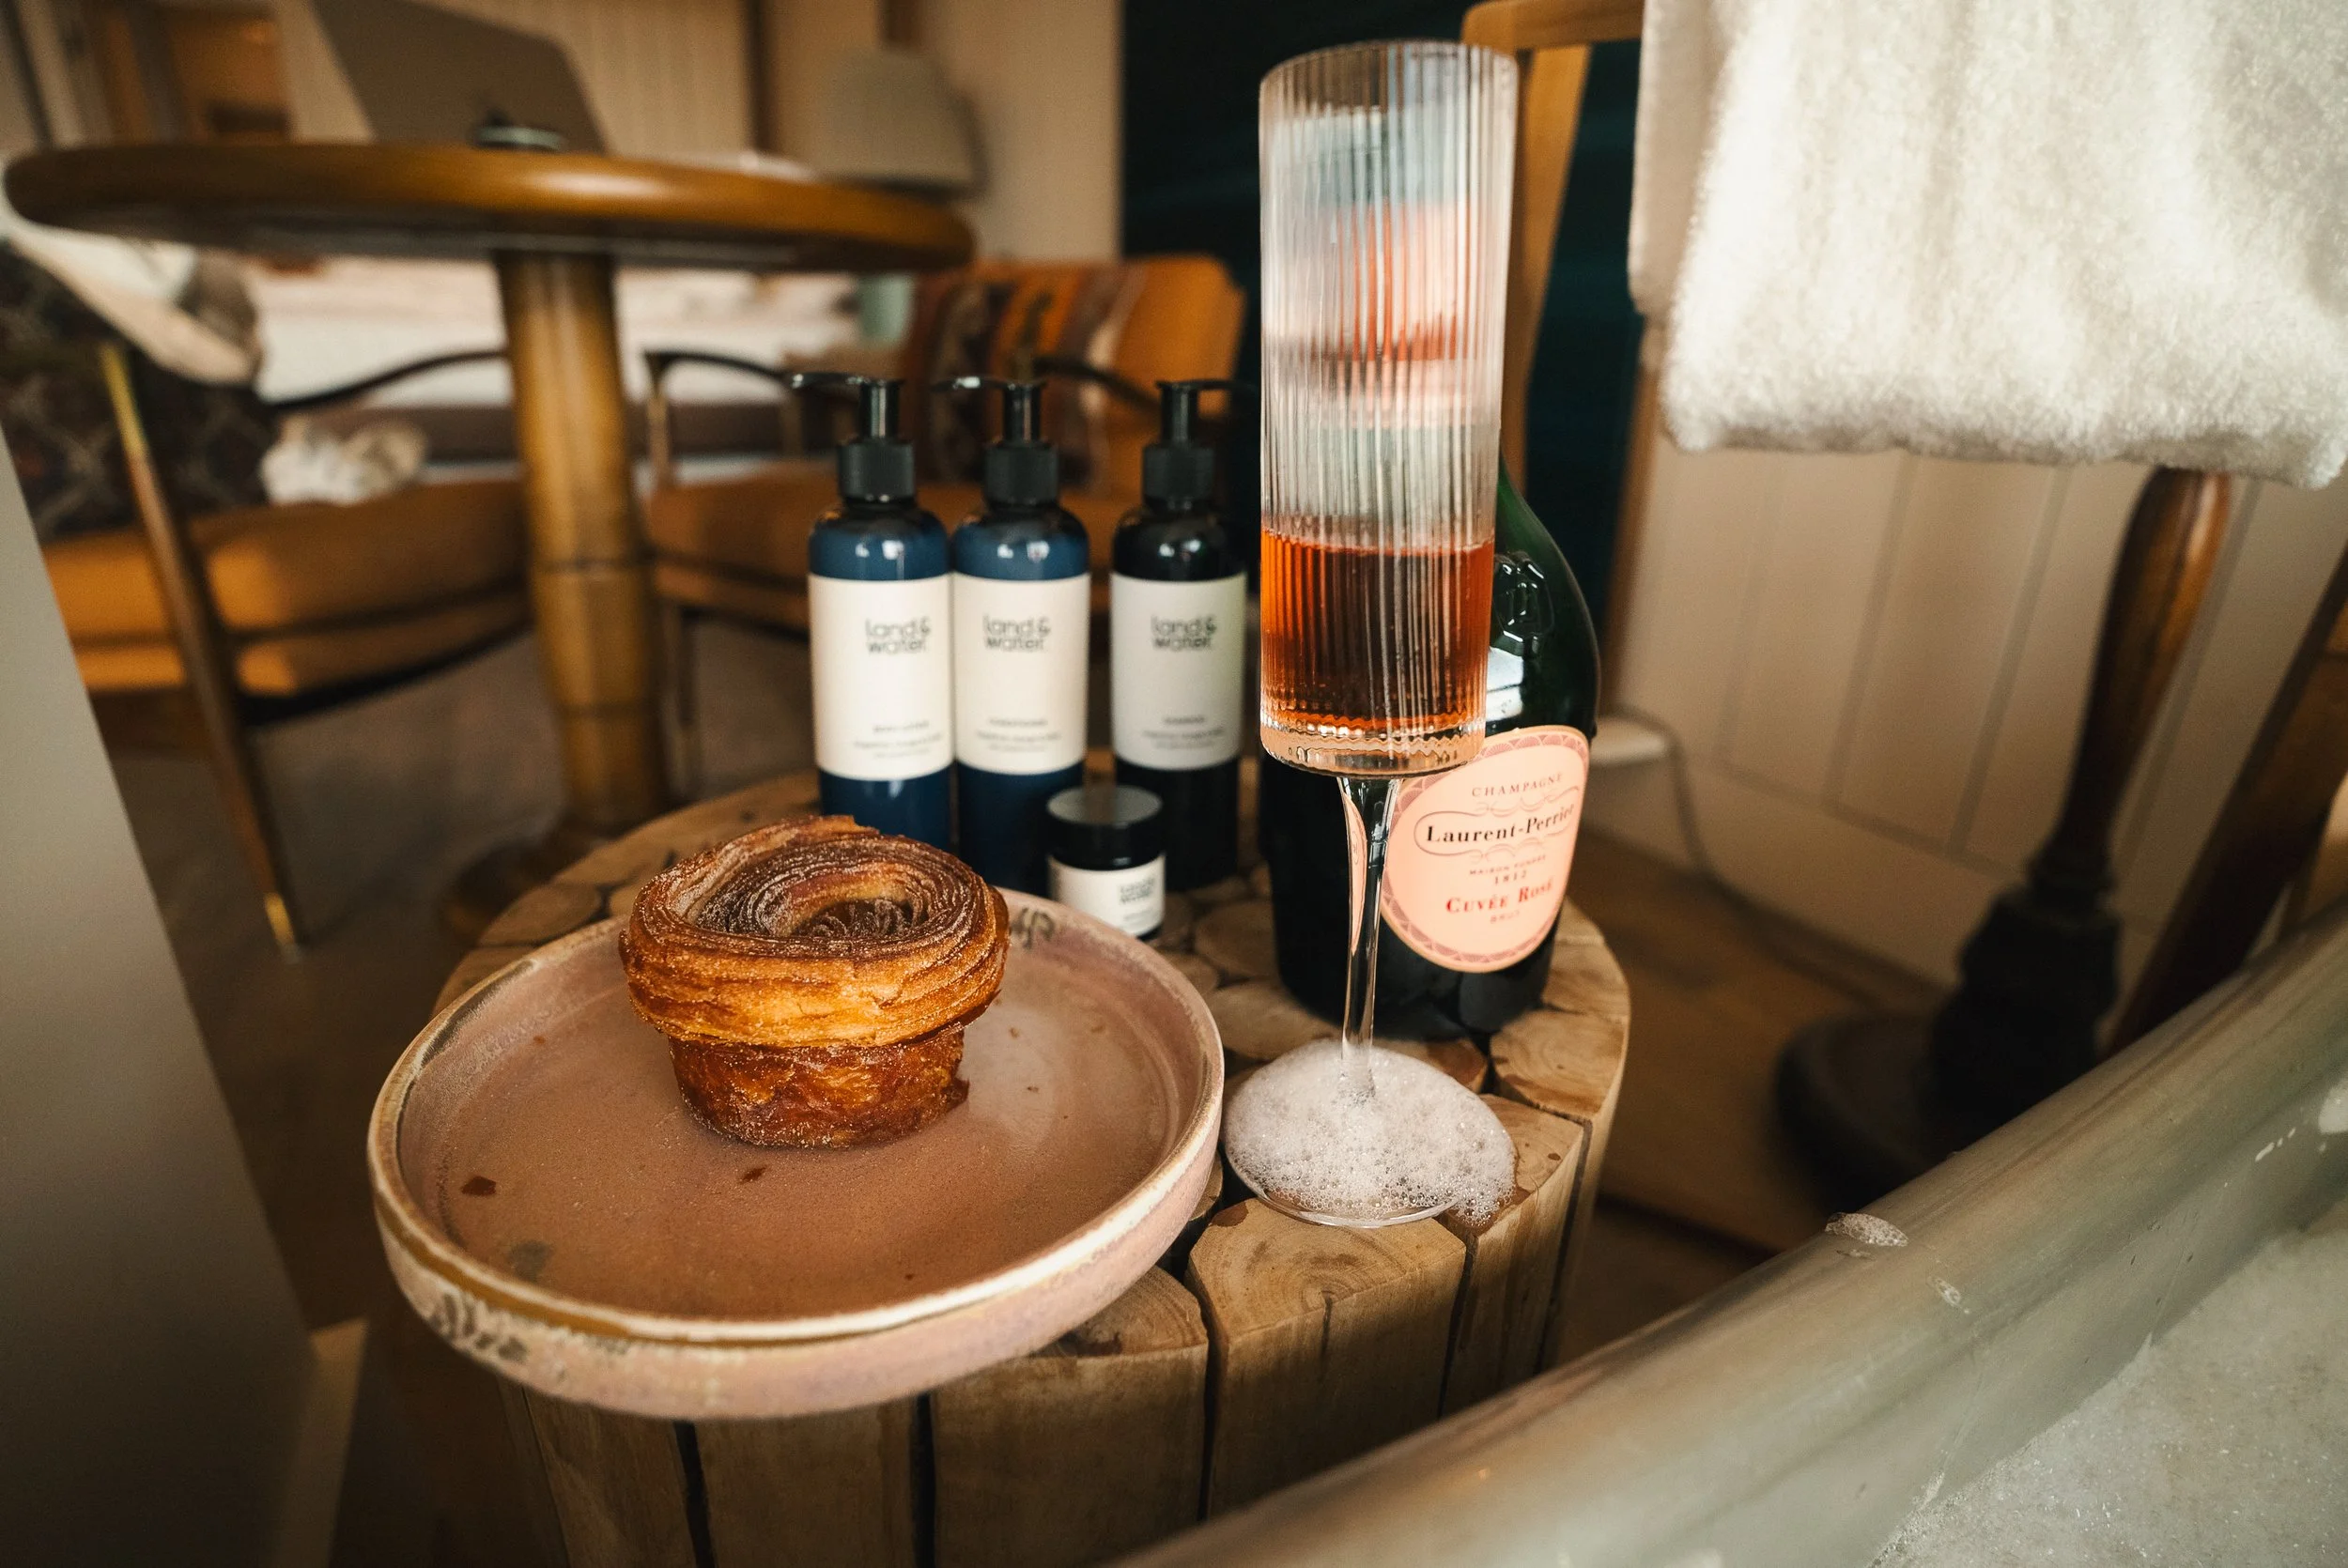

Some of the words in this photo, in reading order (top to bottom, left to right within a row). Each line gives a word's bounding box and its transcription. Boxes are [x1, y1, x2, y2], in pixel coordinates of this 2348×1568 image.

[1472, 773, 1562, 798] CHAMPAGNE
[1427, 804, 1574, 842] Laurent-Perrier
[1494, 869, 1527, 884] 1812
